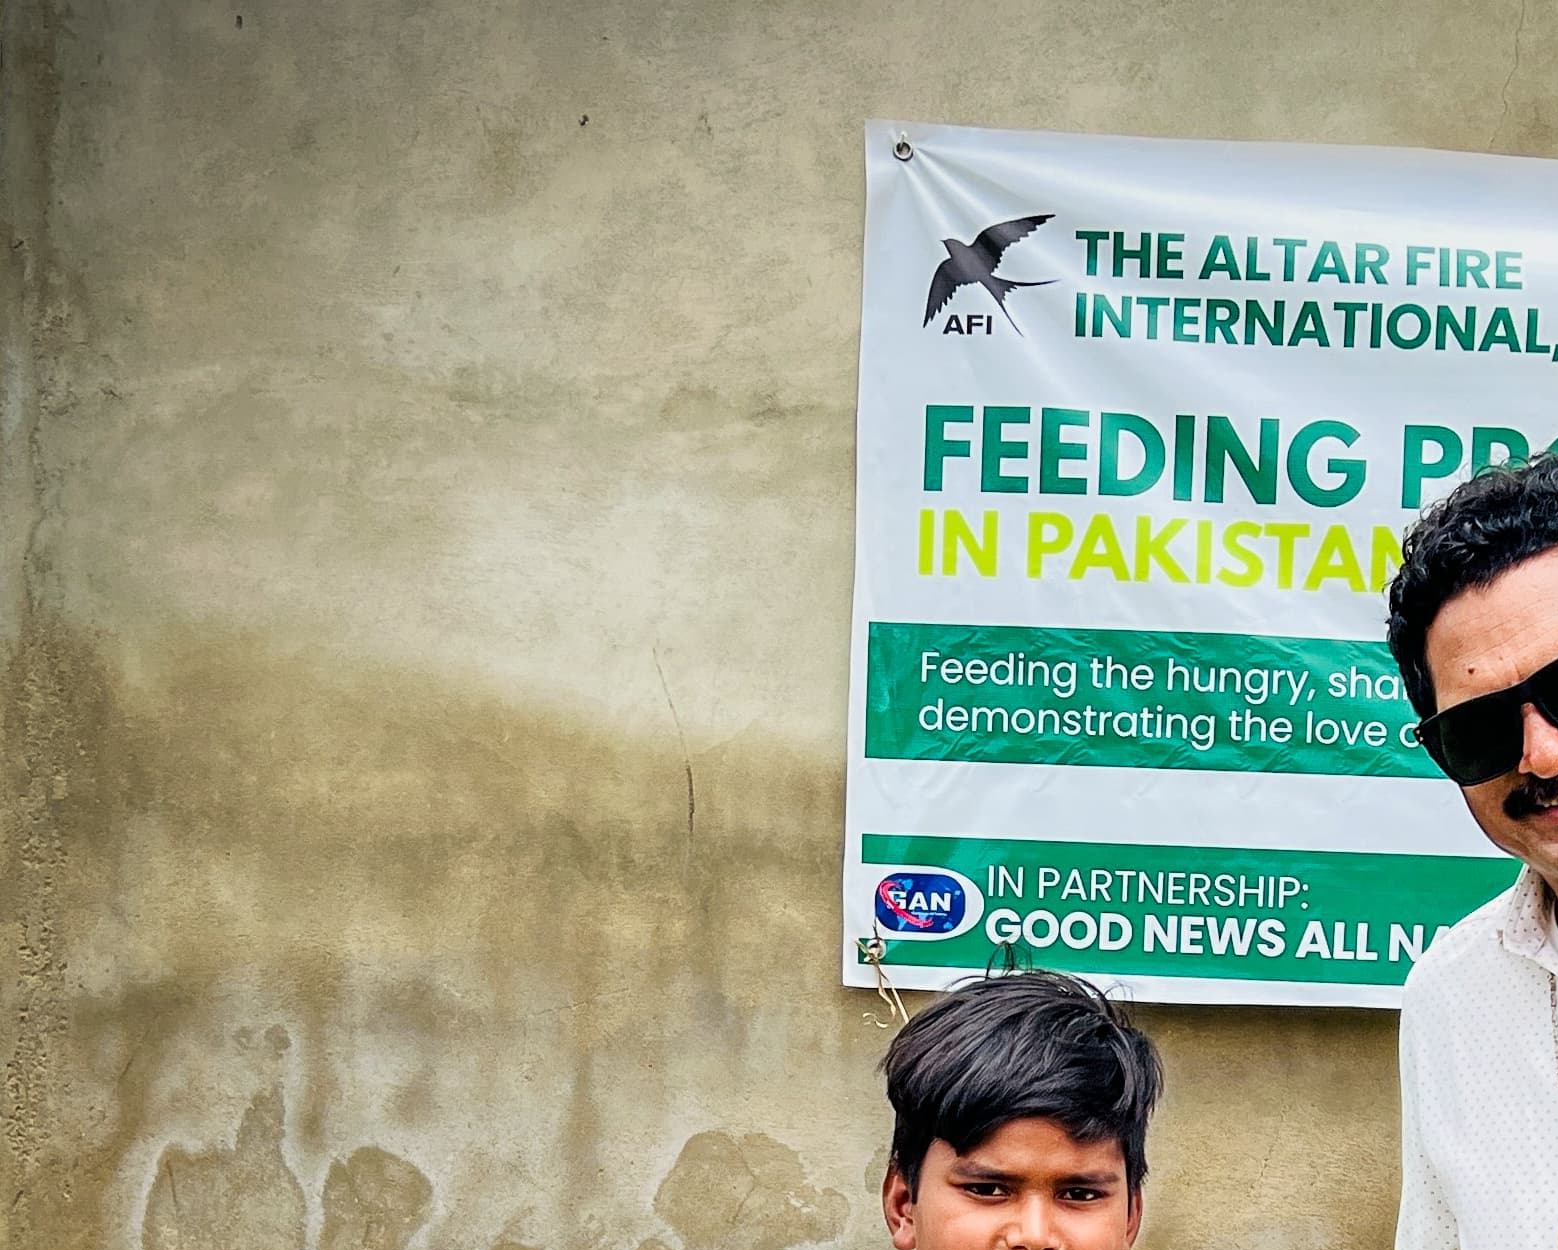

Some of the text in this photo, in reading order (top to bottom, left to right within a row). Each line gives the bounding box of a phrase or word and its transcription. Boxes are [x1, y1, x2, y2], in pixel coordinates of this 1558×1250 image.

[1076, 231, 1524, 290] THE ALTAR FIRE
[943, 314, 993, 336] AFI
[923, 405, 1367, 508] FEEDING
[918, 509, 998, 579] IN
[920, 652, 1077, 698] Feeding
[1090, 656, 1154, 691] the
[1167, 658, 1316, 706] hungry,
[918, 699, 1216, 751] demonstrating
[1229, 708, 1293, 743] the
[1306, 711, 1388, 747] love
[886, 890, 951, 912] GAN
[987, 865, 1310, 911] IN PARTNERSHIP:
[985, 908, 1133, 953] GOOD
[1144, 916, 1286, 957] NEWS
[1296, 921, 1379, 962] ALL
